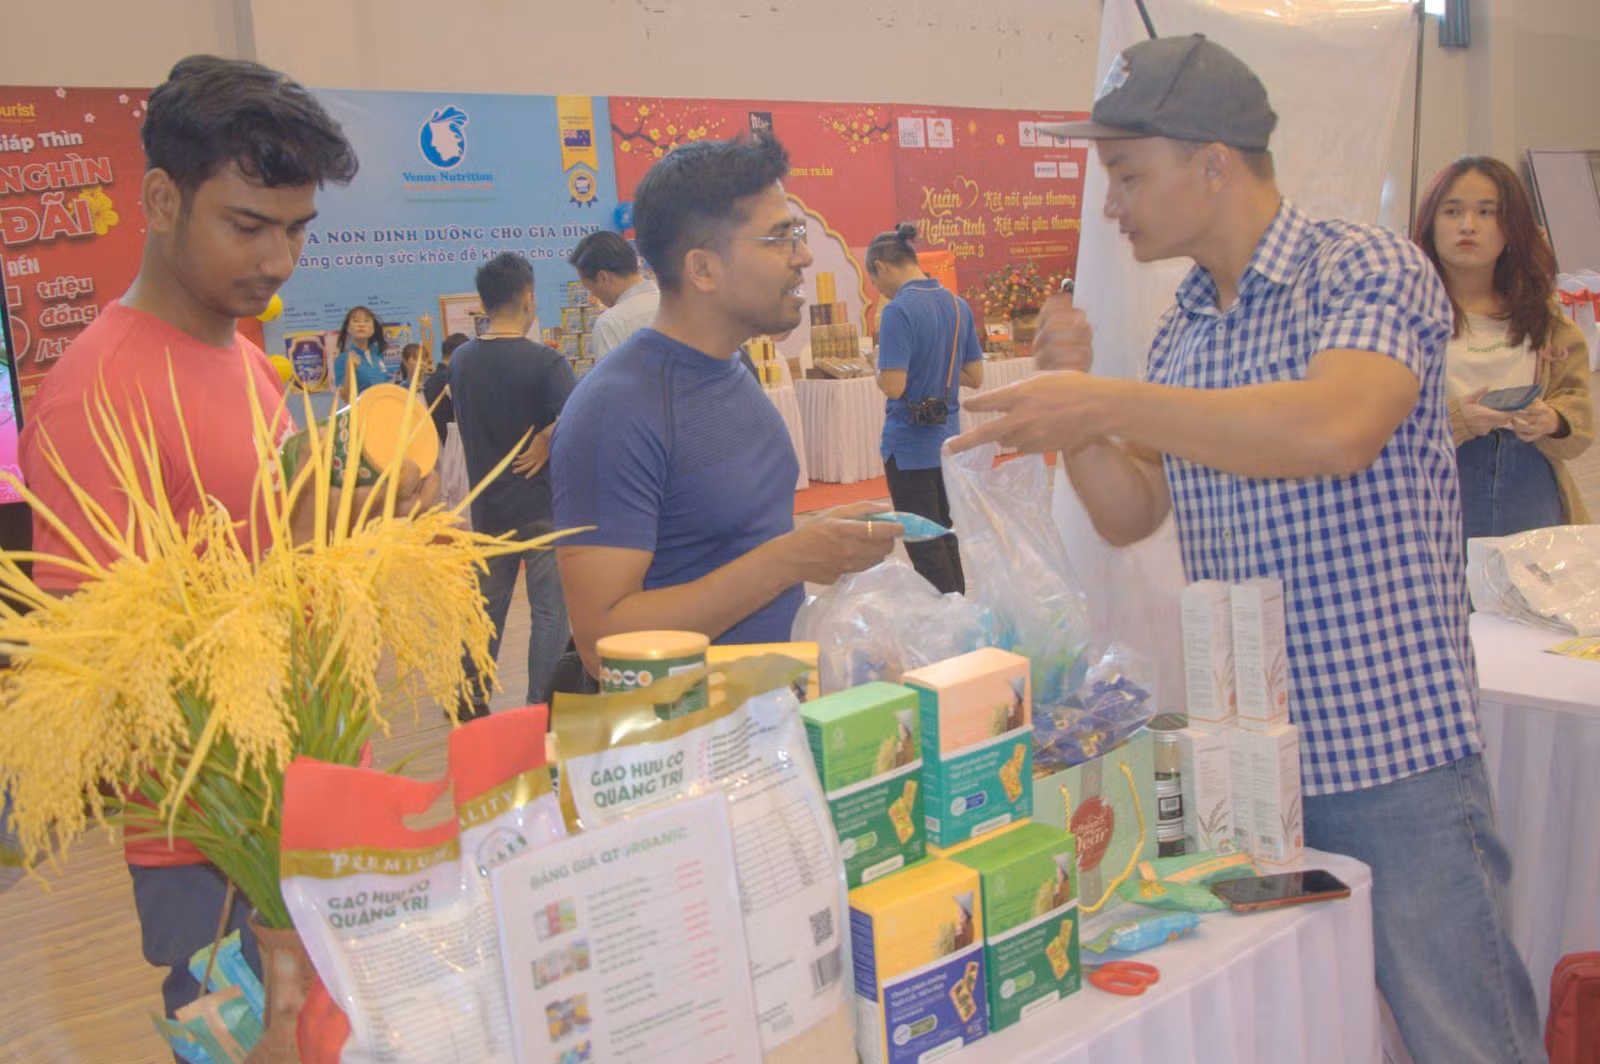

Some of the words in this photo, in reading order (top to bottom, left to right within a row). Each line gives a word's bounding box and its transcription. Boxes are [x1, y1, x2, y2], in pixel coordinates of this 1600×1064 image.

[38, 130, 83, 147] Thìn
[0, 153, 113, 194] NGHÌN
[402, 172, 437, 182] Venus
[440, 172, 494, 182] Nutrition
[921, 186, 961, 217] Xuân
[0, 191, 96, 244] ĐÃI
[327, 230, 366, 243] NON
[373, 229, 418, 242] DINH
[490, 227, 523, 239] CHO
[529, 226, 557, 239] GIA
[916, 218, 960, 244] Nghĩa
[389, 251, 414, 263] sức
[530, 247, 554, 258] cho
[37, 277, 93, 299] triệu
[40, 304, 98, 327] đồng
